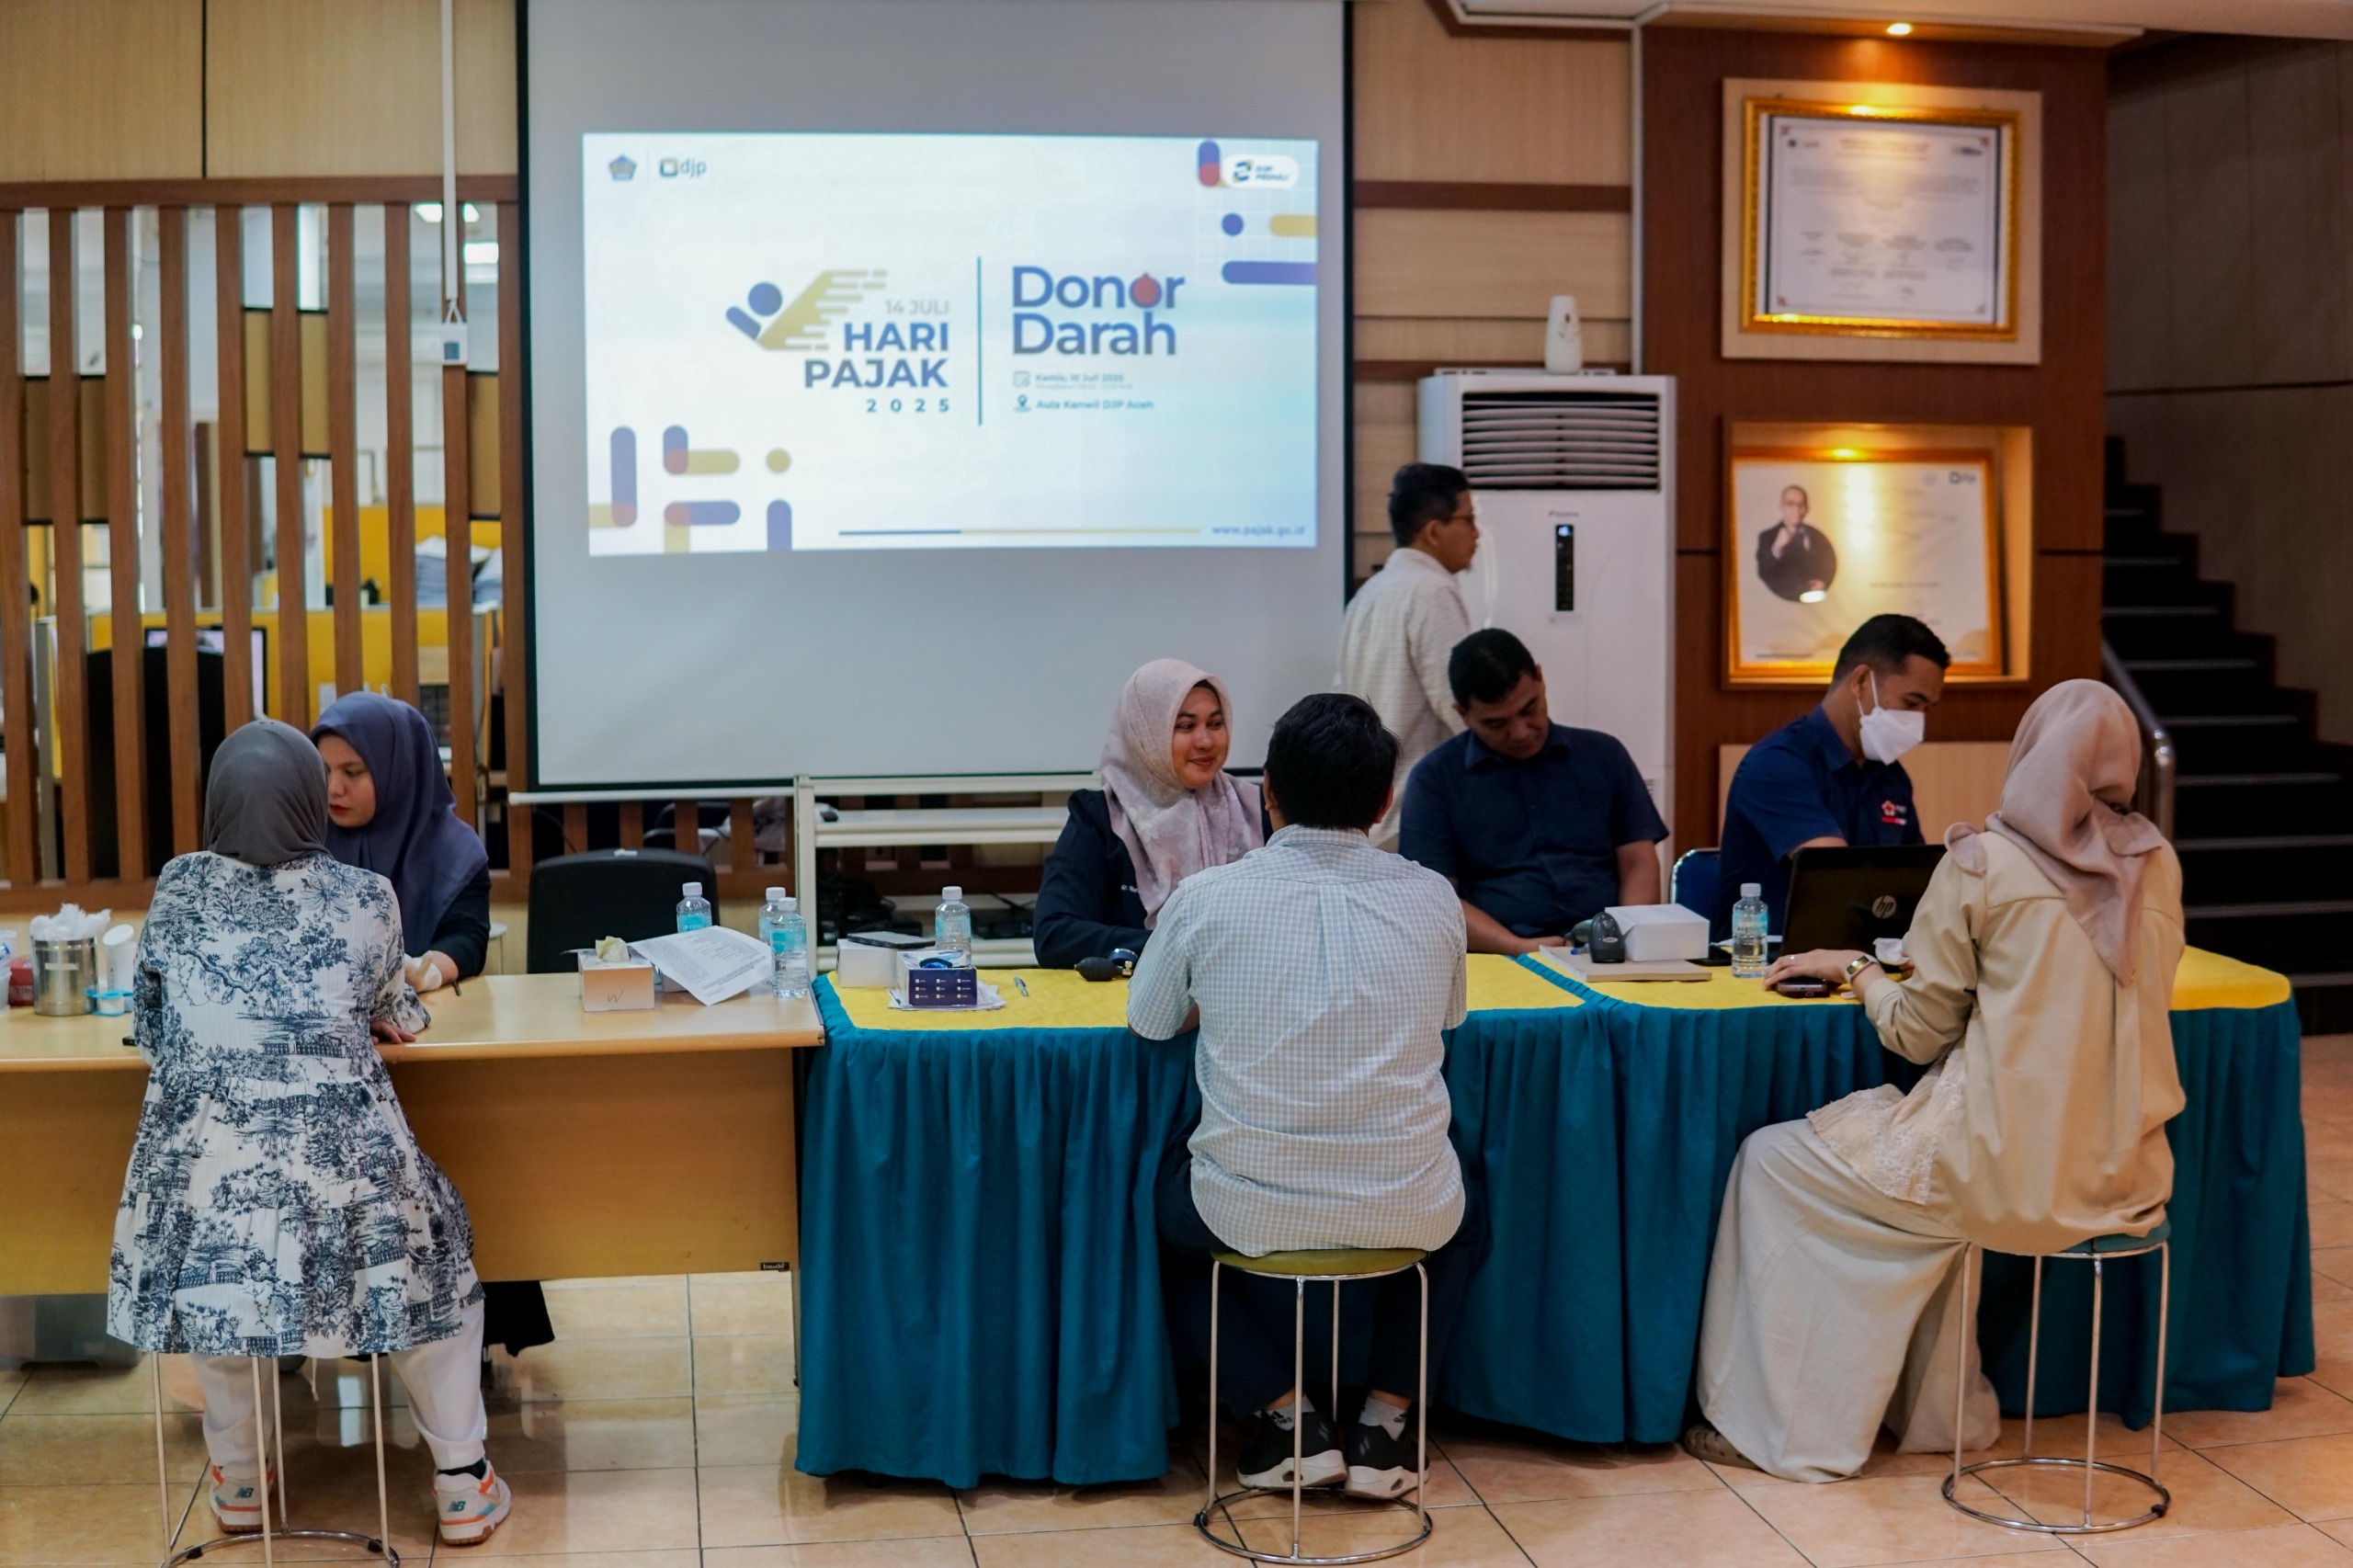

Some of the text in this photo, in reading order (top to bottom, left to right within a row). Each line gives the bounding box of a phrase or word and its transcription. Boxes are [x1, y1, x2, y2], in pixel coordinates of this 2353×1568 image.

[680, 156, 707, 179] djp
[1013, 266, 1186, 309] Donor
[885, 300, 949, 315] 14 JULI
[844, 322, 949, 352] HARI
[1013, 311, 1176, 355] Darah
[804, 358, 949, 389] PAJAK
[866, 398, 950, 413] 2025
[1036, 399, 1061, 409] Aula
[1103, 399, 1124, 409] DJP
[1126, 399, 1154, 409] Aceh
[1213, 526, 1304, 537] www.pajak.go.id
[1875, 895, 1894, 918] hp
